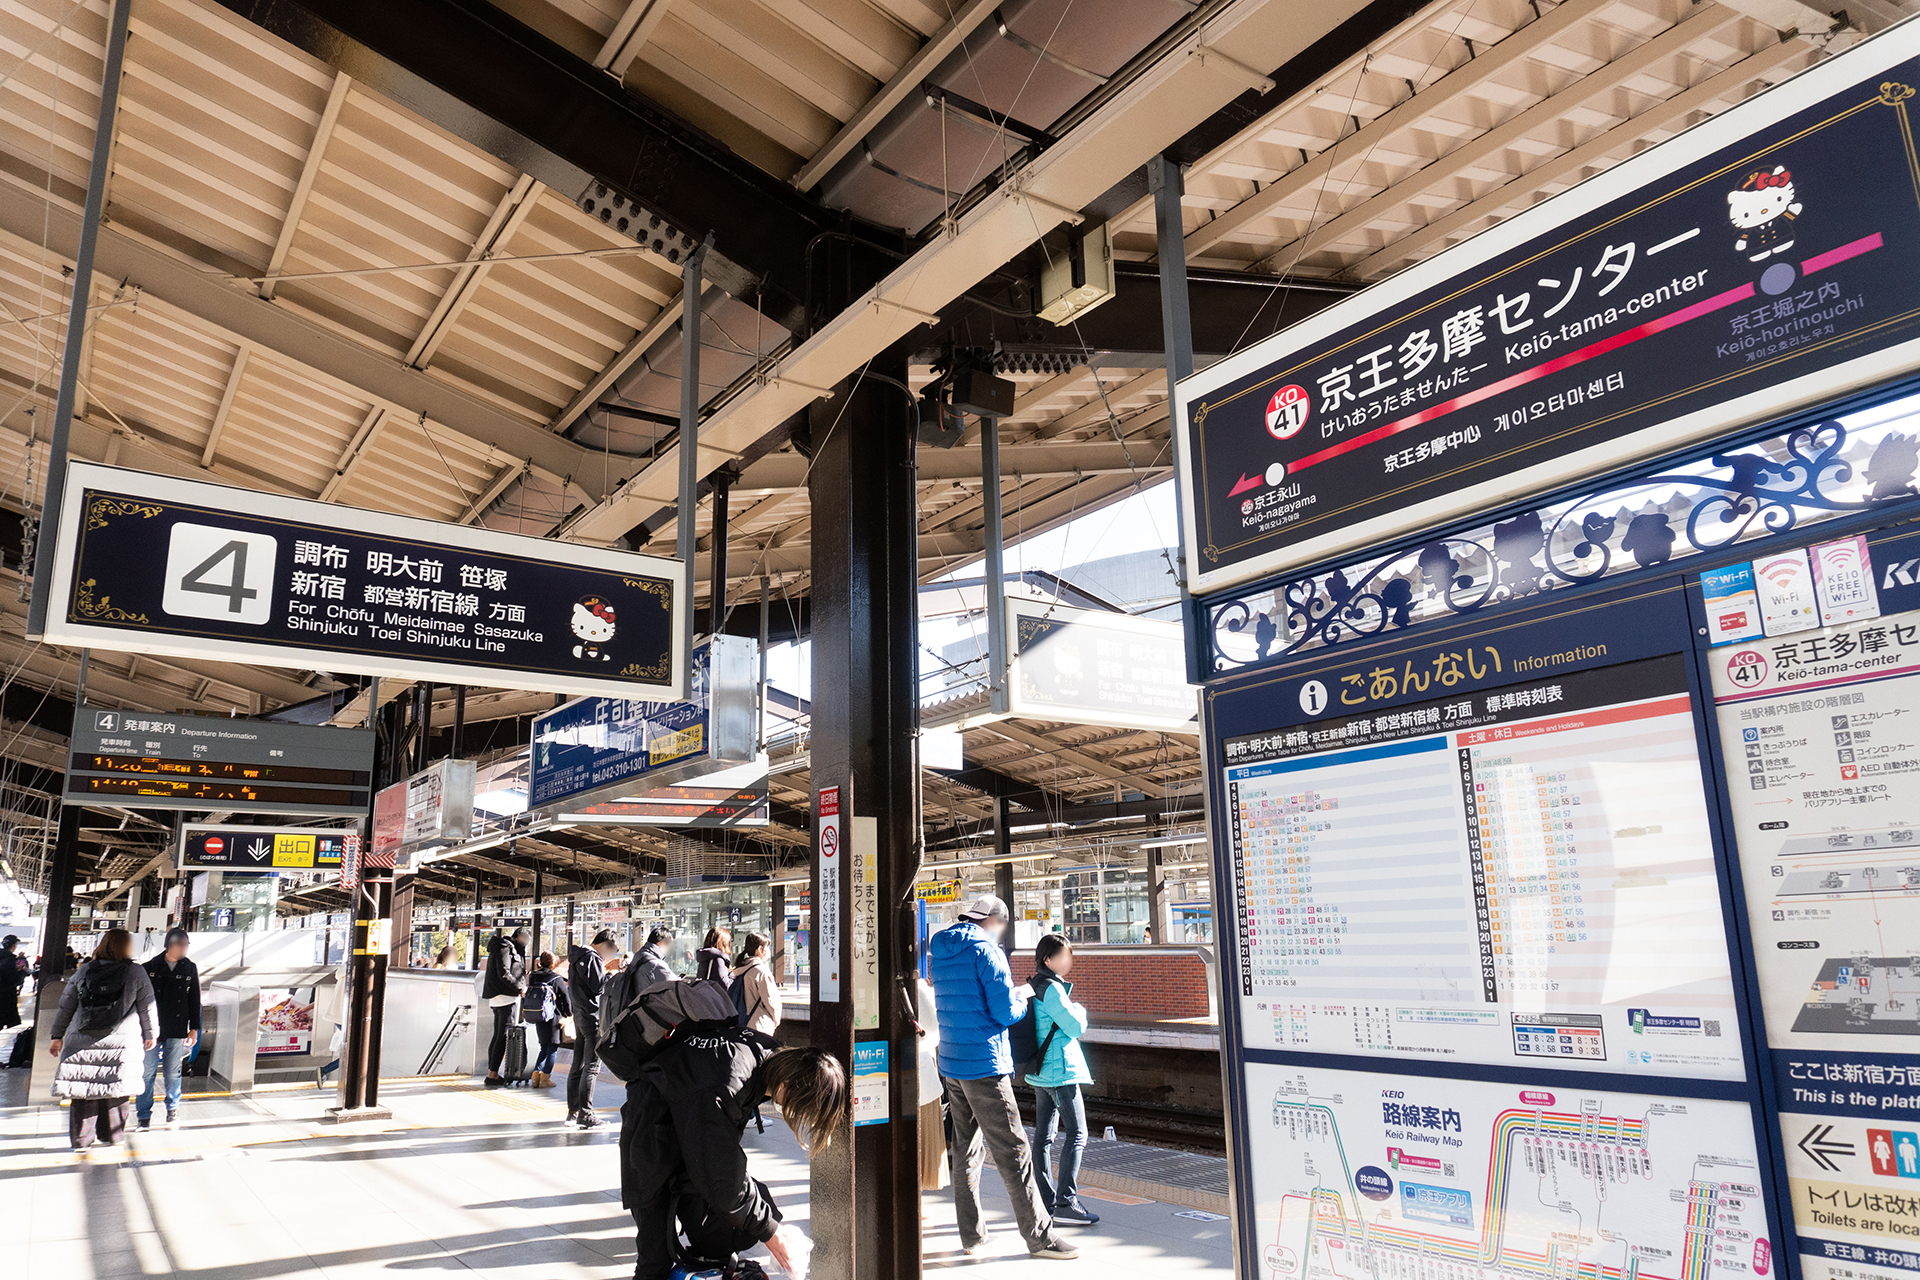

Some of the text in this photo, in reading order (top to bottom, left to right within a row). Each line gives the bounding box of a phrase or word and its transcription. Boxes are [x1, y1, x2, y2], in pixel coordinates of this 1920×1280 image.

[1505, 266, 1708, 364] Keiō-tama-center
[1729, 281, 1840, 336] 京王堀之内
[1318, 226, 1700, 415] 京王多摩センター
[1716, 294, 1864, 358] Keiō-horinouchi
[1275, 388, 1298, 409] KO
[1321, 363, 1488, 439] けいおうたませんたー
[1494, 371, 1625, 433] 게이오타마센터
[1273, 408, 1302, 431] 41
[1383, 424, 1482, 474] 京王多摩中心
[1254, 482, 1301, 511] 京王永山
[1242, 494, 1317, 528] Keiō-nagayama
[294, 540, 508, 592] 調布 明大前 笹塚
[180, 539, 258, 614] 4
[1719, 571, 1749, 584] Wi-Fi
[1828, 570, 1859, 583] KEIO
[1829, 581, 1861, 594] FREE
[290, 570, 526, 623] 新宿 都営新宿線 方面
[1771, 591, 1799, 606] Wi-Fi
[1832, 590, 1863, 603] Wi-Fi
[288, 600, 544, 643] For Chōfu Meidaimae Sasazuka
[287, 616, 506, 653] Shinjuku Toei Shinjuku Line
[1514, 644, 1608, 673] Information
[1735, 654, 1757, 666] KO
[1735, 665, 1760, 682] 41
[1777, 653, 1902, 682] Keiō-tama-center
[1340, 646, 1502, 705] ごあんない
[1443, 701, 1472, 720] 方面
[1486, 685, 1563, 713] 標準時刻表
[1740, 692, 1865, 721] 当駅構内施設の階層図
[1851, 708, 1910, 722] エスカレーター
[99, 714, 258, 740] 4 発車案内 Departure Information
[1515, 720, 1584, 738] Weekends and Holidays
[1760, 725, 1784, 735] 案内所
[1853, 730, 1871, 739] 階段
[1265, 750, 1277, 758] Time
[1278, 748, 1290, 756] Table
[1383, 731, 1397, 739] New
[1398, 728, 1409, 737] Line
[1410, 723, 1435, 735] Shinjuku
[1436, 722, 1441, 730] &
[1442, 720, 1455, 729] Toei
[1456, 716, 1482, 728] Shinjuku
[1483, 713, 1497, 722] Line
[1468, 728, 1512, 744] 土曜・休日
[100, 738, 131, 747] 発車時刻
[145, 741, 161, 749] 種別
[193, 744, 208, 752] 行先
[1763, 738, 1807, 751] きっぷうりば
[1856, 743, 1915, 756] コインロッカー
[1461, 750, 1468, 759] 4
[1765, 757, 1790, 767] 待合室
[1236, 769, 1250, 778] 平日
[1860, 763, 1880, 773] AED
[1464, 772, 1470, 781] 6
[1768, 772, 1815, 783] エレベーター
[820, 791, 838, 805] 終日禁煙
[1466, 794, 1473, 803] 8
[1802, 784, 1887, 799] 現在地から地上までの
[1804, 793, 1892, 808] バリアフリー主要ルート
[1467, 817, 1477, 826] 10
[279, 839, 310, 854] 出口
[1474, 874, 1483, 883] 15
[1773, 867, 1782, 876] 3
[1475, 885, 1485, 895] 16
[853, 854, 864, 959] お待ちください
[829, 868, 837, 961] 駅構内は禁煙です。
[865, 854, 876, 975] 黄線までさがって
[1774, 911, 1784, 921] 4
[1480, 932, 1490, 942] 20
[1482, 956, 1493, 965] 22
[1486, 980, 1493, 989] 0
[1489, 992, 1494, 1001] 1
[858, 1049, 885, 1060] Wi-Fi
[1382, 1090, 1405, 1099] KEIO
[1793, 1088, 1827, 1103] This
[1831, 1090, 1845, 1104] is
[1849, 1092, 1878, 1106] the
[1382, 1102, 1462, 1132] 路線案内
[1385, 1129, 1463, 1148] Keiō Railway Map
[1360, 1174, 1388, 1187] 井の頭線
[1418, 1189, 1467, 1207] 京王アプリ
[1811, 1209, 1857, 1228] Toilets
[1861, 1219, 1884, 1231] are
[1823, 1242, 1920, 1269] 京王線・井の頭
